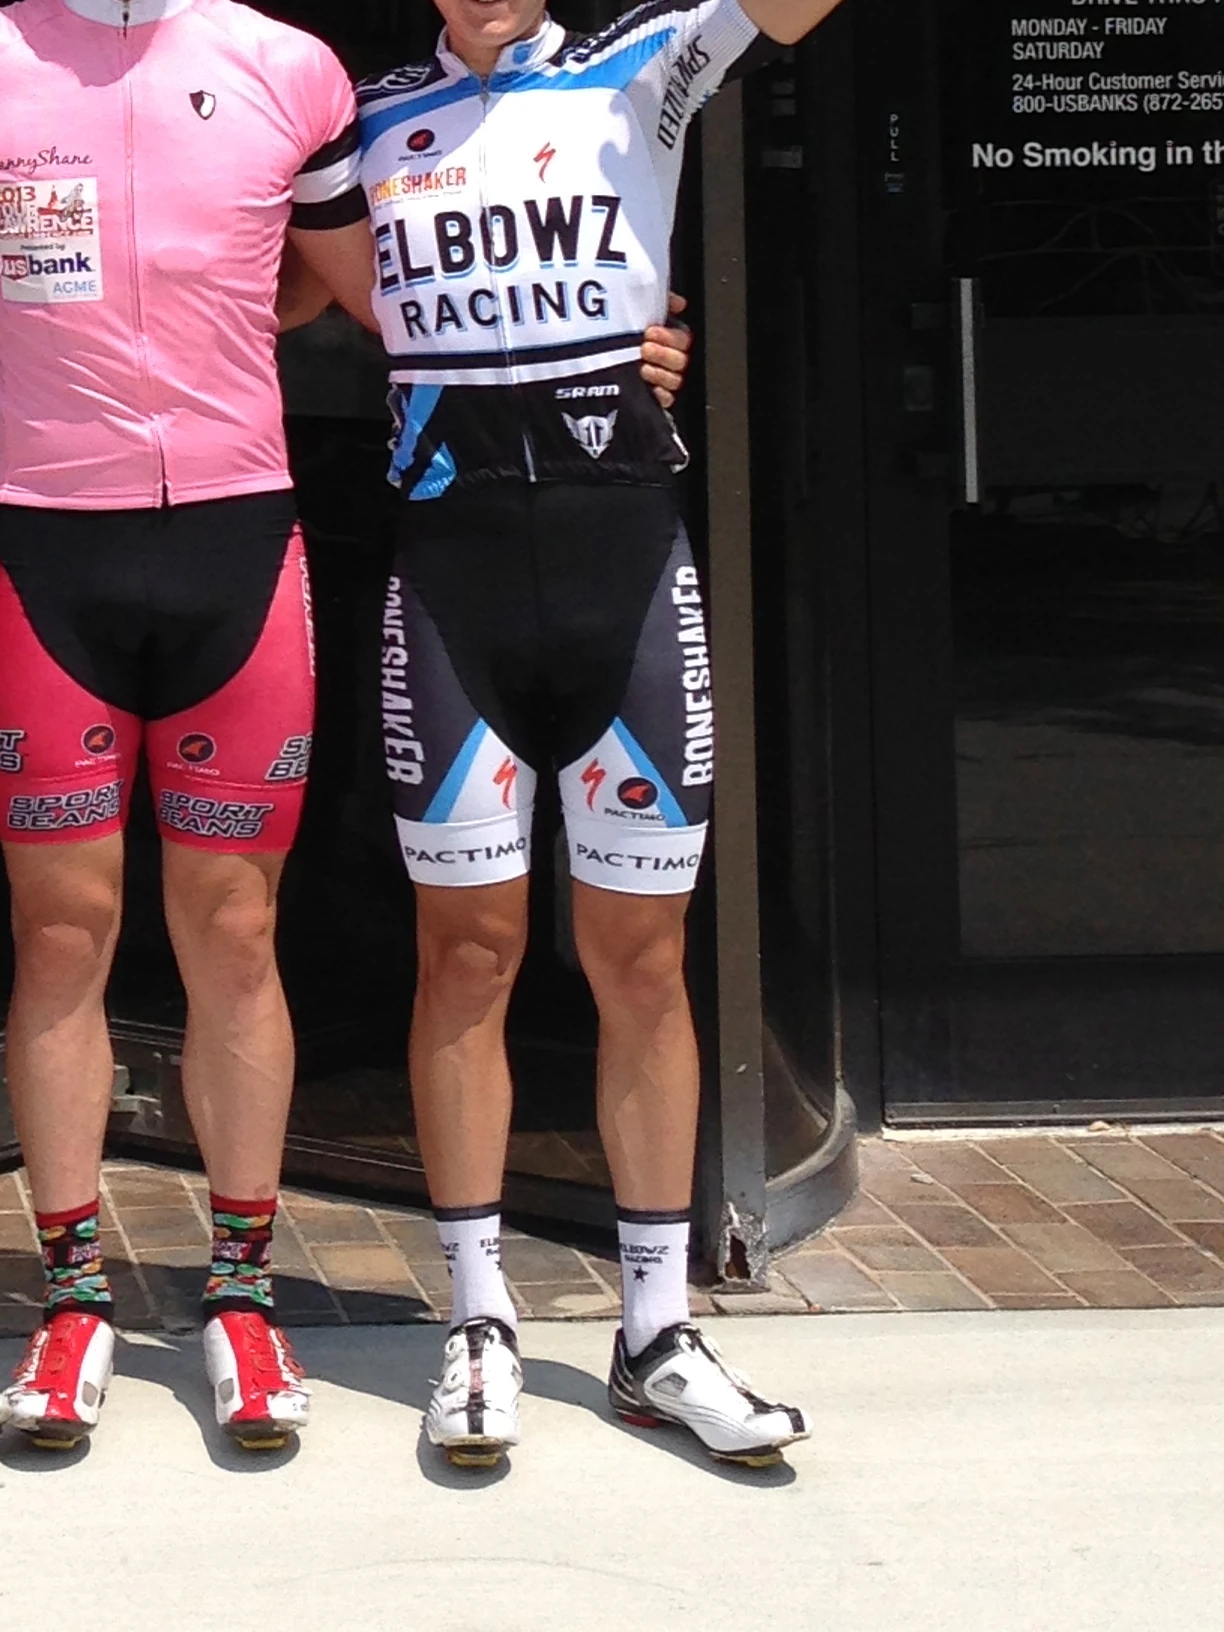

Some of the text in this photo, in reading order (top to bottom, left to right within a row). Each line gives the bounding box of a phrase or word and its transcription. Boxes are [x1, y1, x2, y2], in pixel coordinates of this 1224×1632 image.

[1011, 18, 1087, 37] MONDAY
[1105, 17, 1167, 35] FRIDAY
[1012, 41, 1104, 60] SATURDAY
[1012, 71, 1224, 91] 24-Hour Customer Servi
[1012, 93, 1224, 116] 800-USBANKS (872-265
[972, 143, 1014, 168] No
[1023, 141, 1156, 171] Smoking
[1166, 140, 1193, 166] in
[375, 195, 628, 295] ELBOWZ
[28, 252, 92, 276] bank
[400, 279, 609, 339] RACING
[555, 384, 620, 399] SRAM
[10, 779, 124, 812] SPORT
[160, 789, 274, 821] SPORT
[405, 836, 527, 865] PACTIMO
[576, 843, 699, 871] PACTIMO
